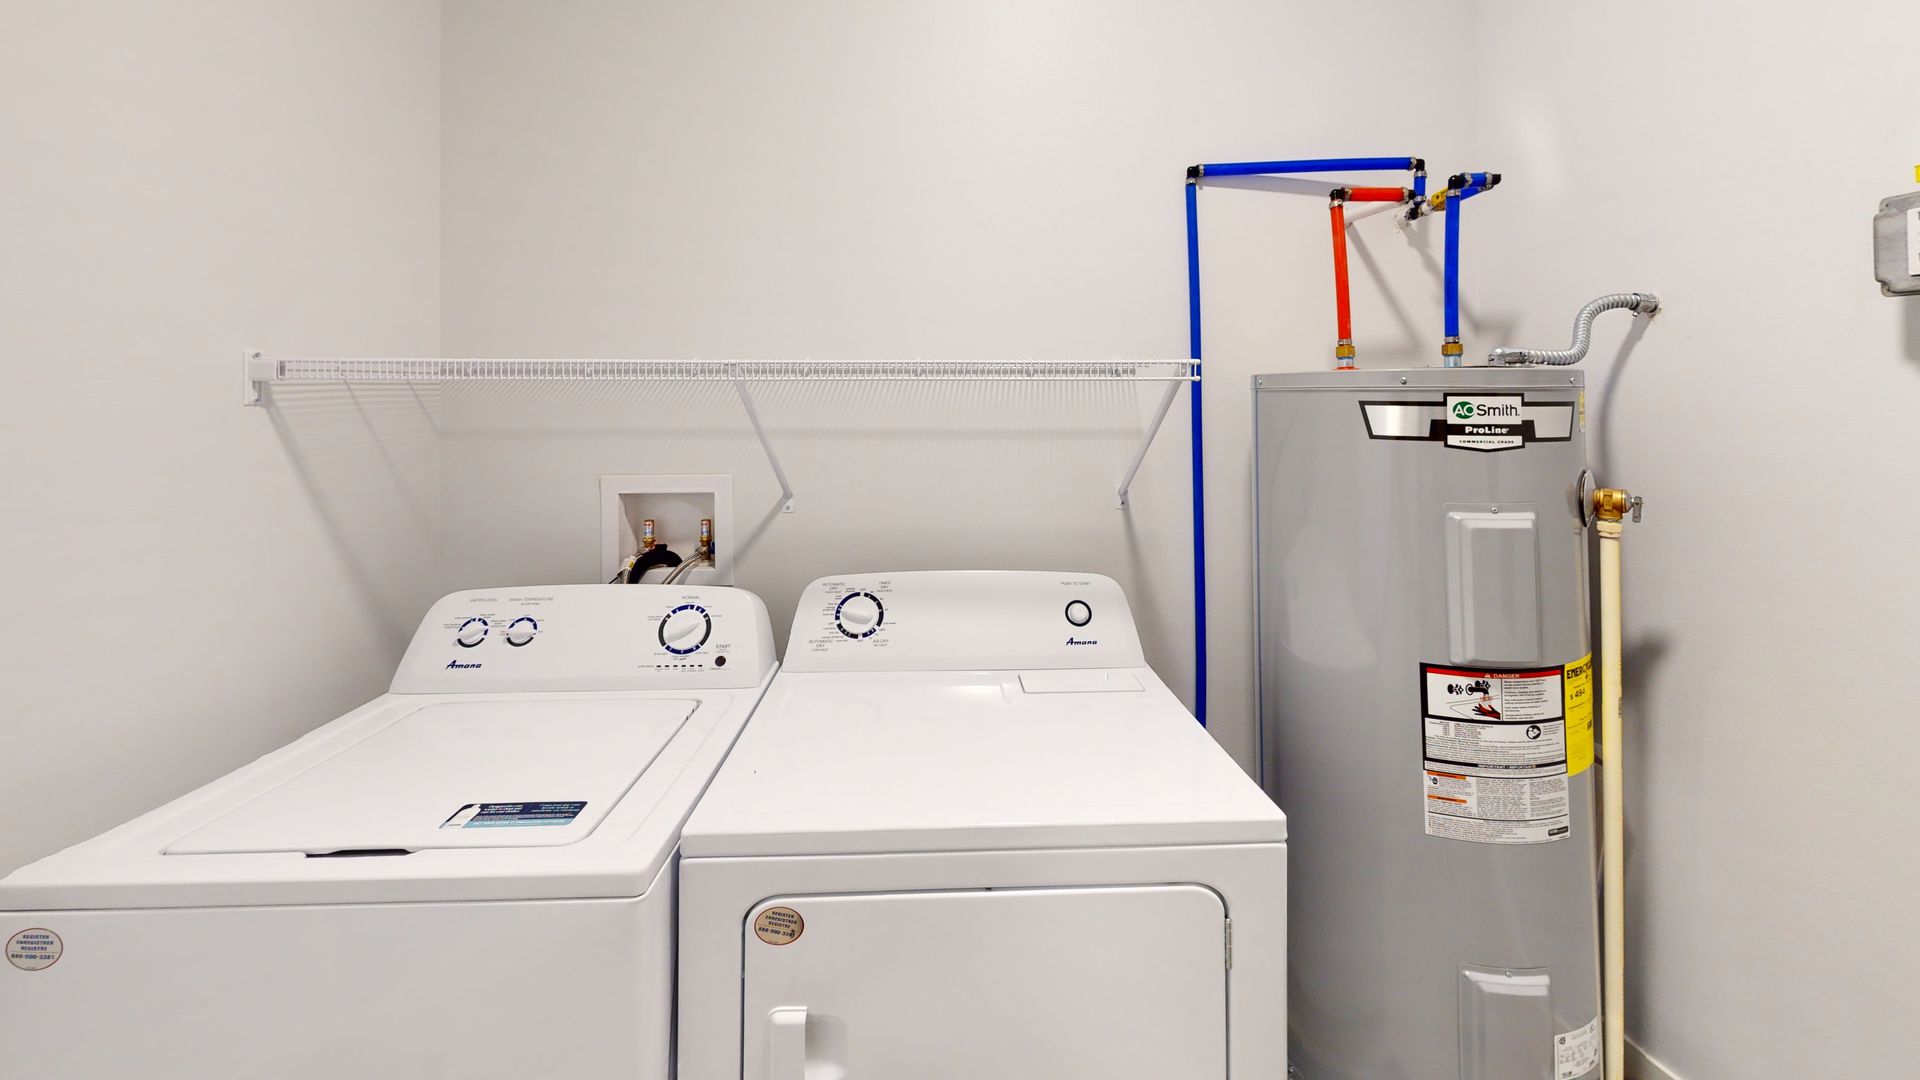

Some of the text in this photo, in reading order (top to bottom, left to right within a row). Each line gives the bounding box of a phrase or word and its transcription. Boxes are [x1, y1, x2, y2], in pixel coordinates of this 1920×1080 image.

[1464, 425, 1508, 434] ProLine
[1065, 636, 1098, 646] Amana
[445, 659, 482, 669] Amana
